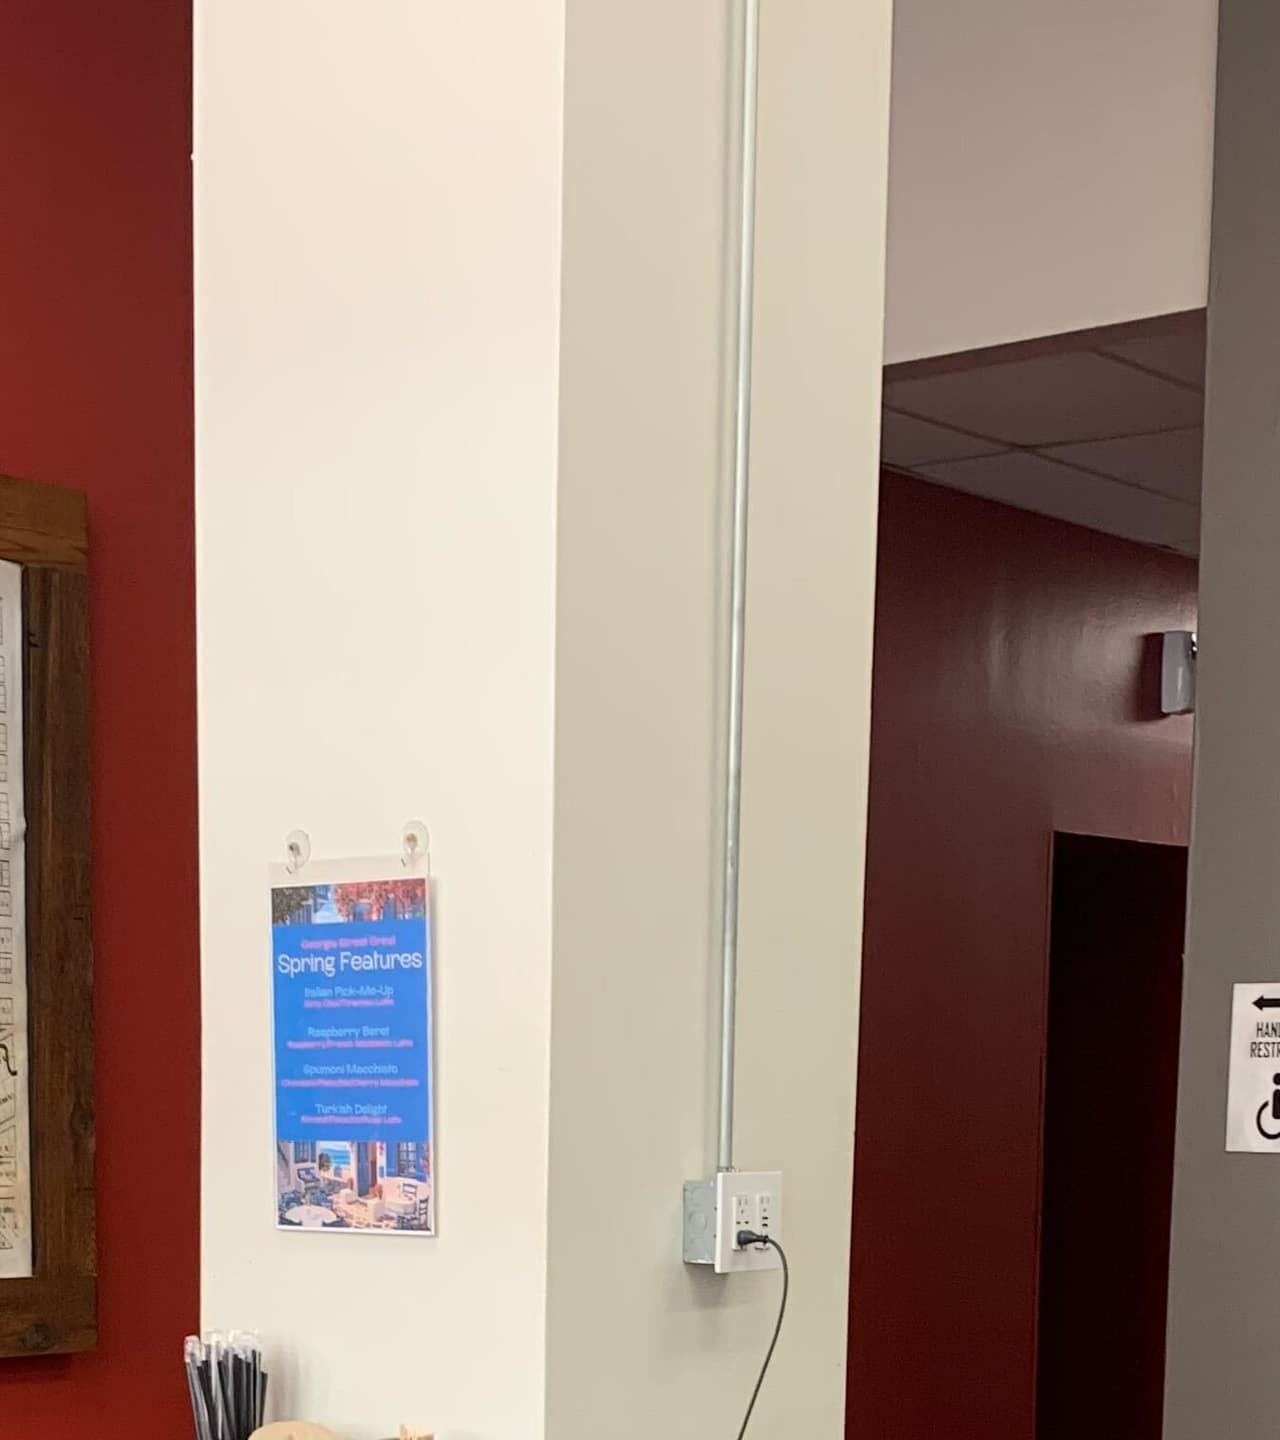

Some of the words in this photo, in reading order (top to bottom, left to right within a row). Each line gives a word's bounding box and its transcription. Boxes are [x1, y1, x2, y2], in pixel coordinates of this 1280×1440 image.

[278, 953, 336, 978] Spring
[340, 951, 423, 971] Features
[307, 1026, 360, 1039] Raspberry
